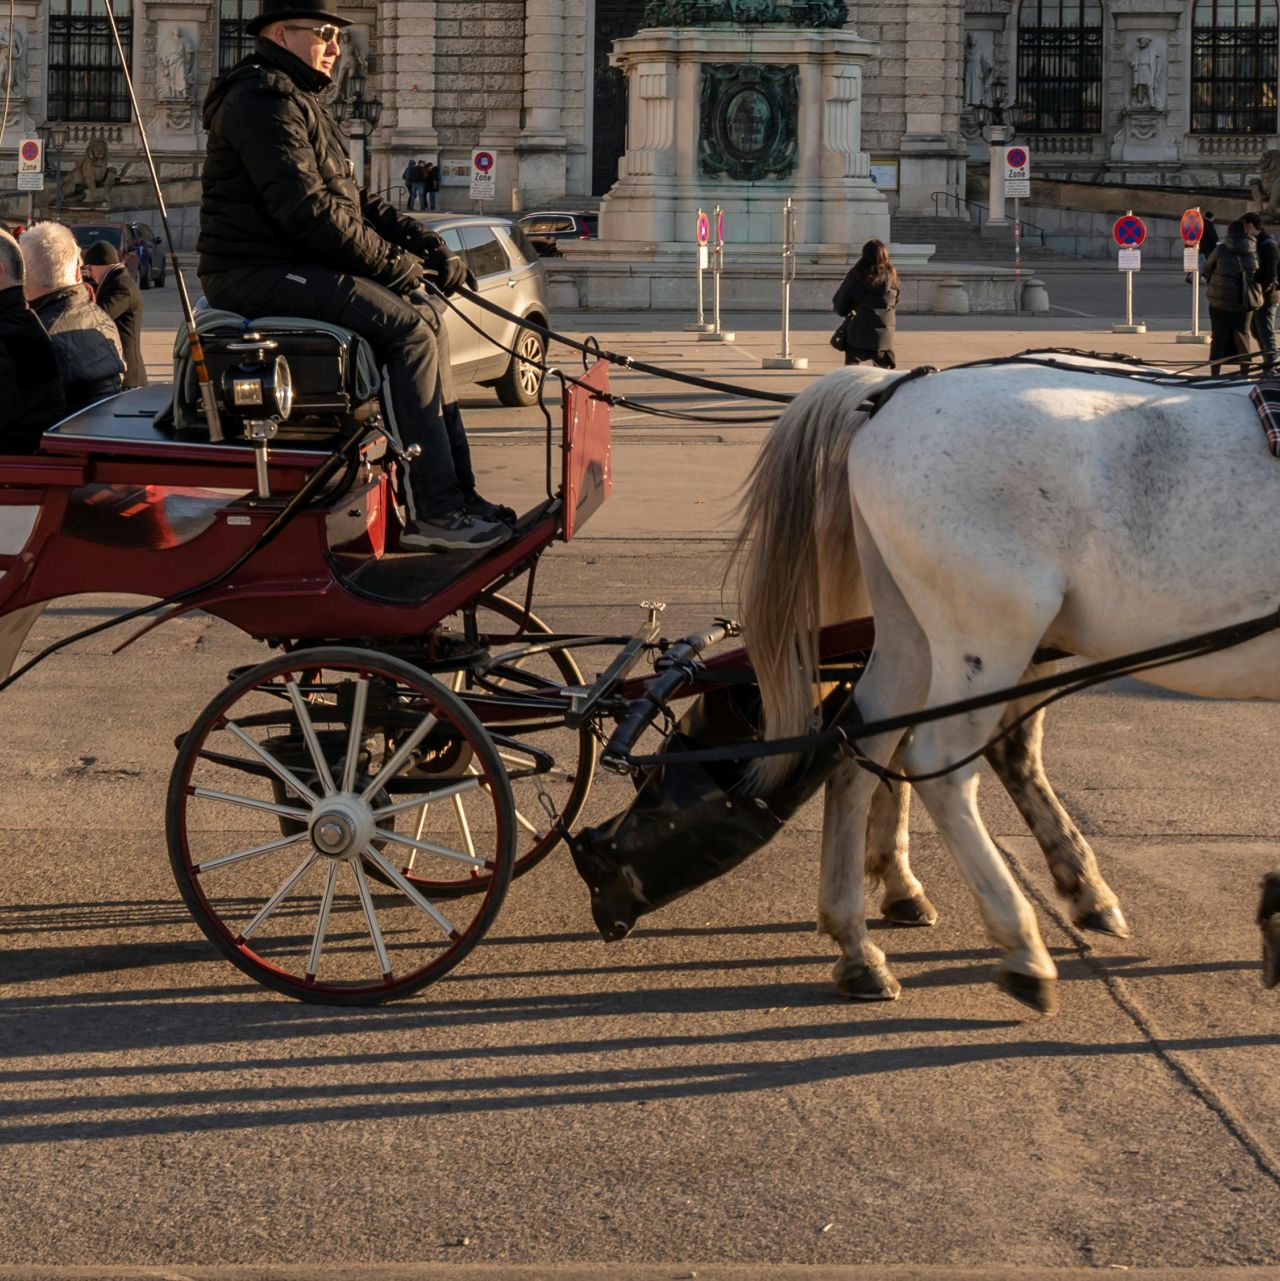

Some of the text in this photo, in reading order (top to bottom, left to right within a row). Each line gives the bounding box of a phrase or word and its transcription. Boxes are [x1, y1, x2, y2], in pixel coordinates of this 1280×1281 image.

[22, 163, 38, 171] Zone
[475, 173, 492, 181] Zone
[1008, 170, 1026, 178] Zone
